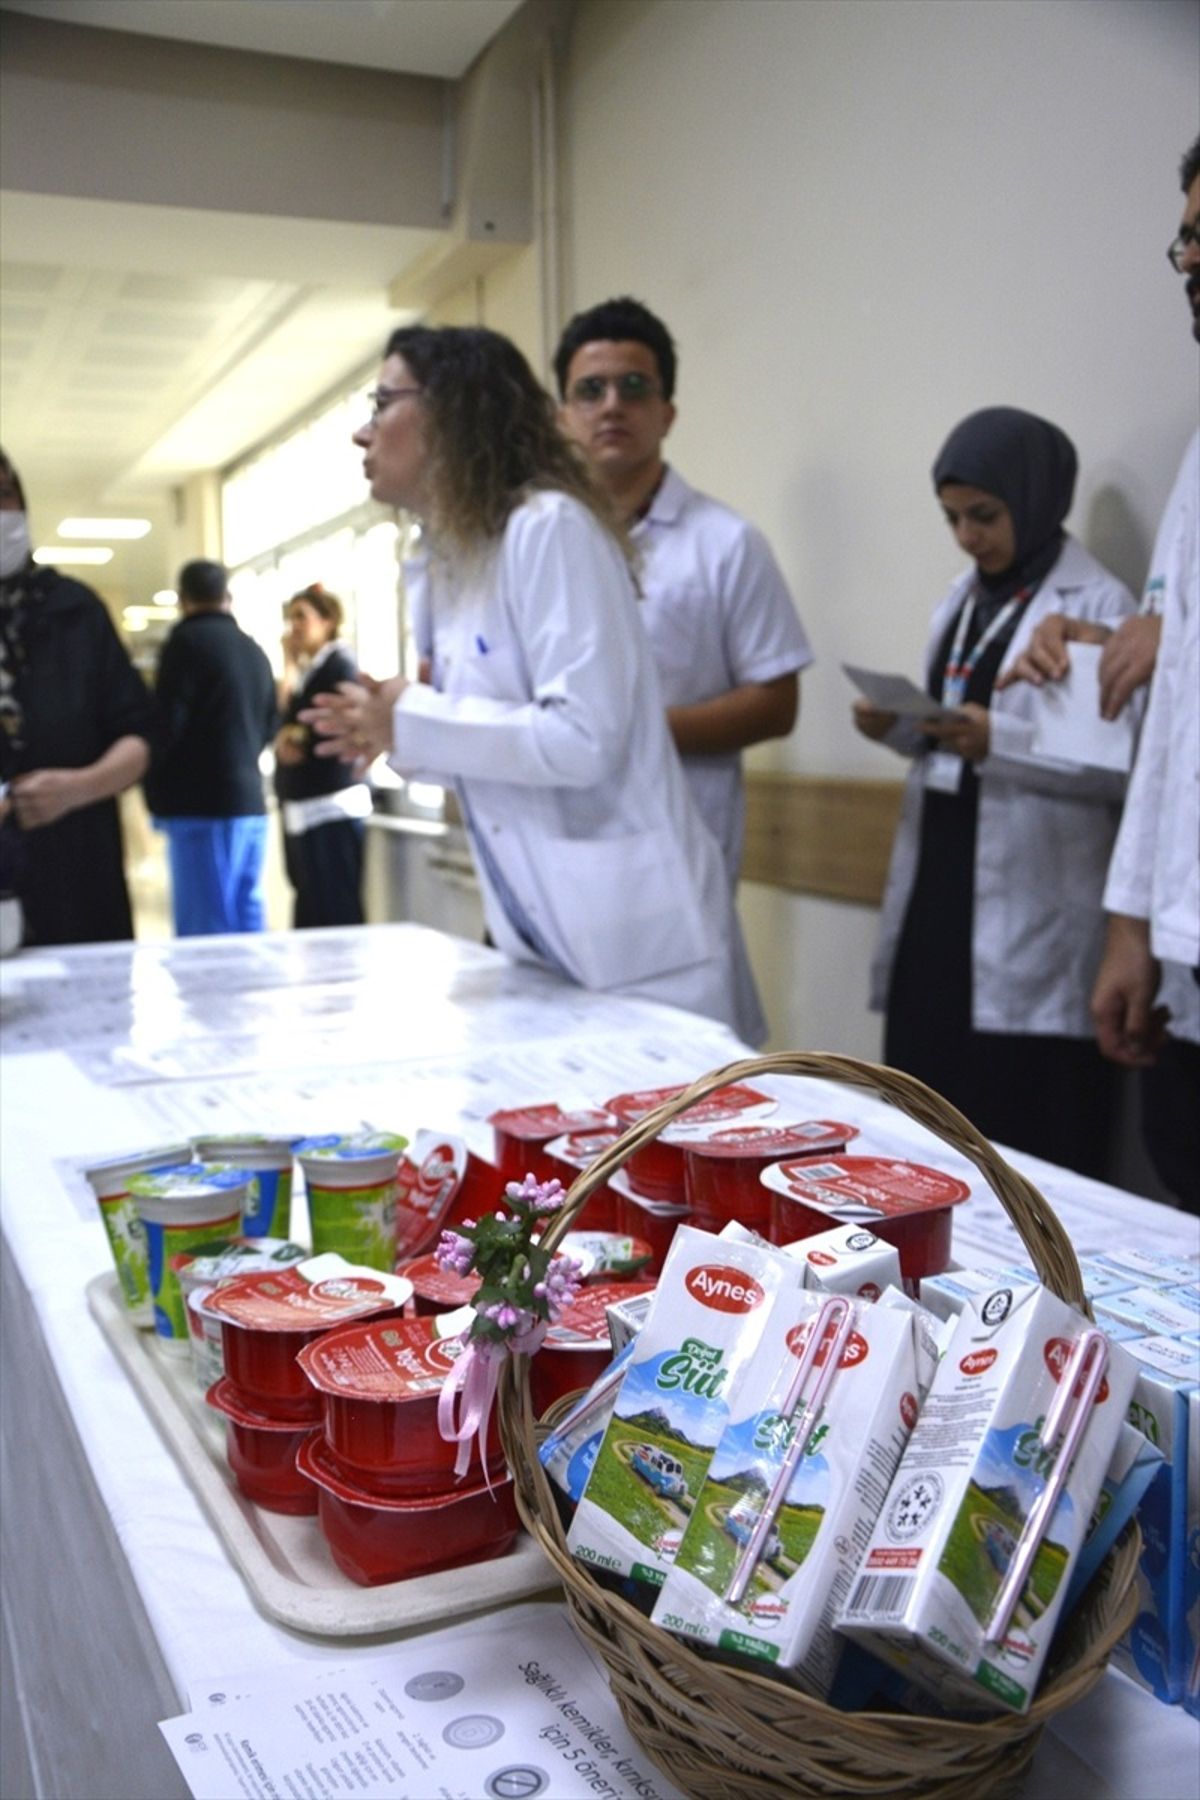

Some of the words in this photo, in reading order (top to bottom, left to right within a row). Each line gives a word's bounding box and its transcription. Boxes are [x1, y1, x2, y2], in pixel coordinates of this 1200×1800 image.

[691, 1270, 759, 1305] Aynes
[656, 1354, 728, 1399] Süt
[576, 1544, 597, 1561] 200
[662, 1613, 684, 1629] 200
[683, 1620, 700, 1634] ml
[518, 1660, 567, 1702] Sağlıklı
[557, 1700, 618, 1759] kemikler,
[538, 1723, 571, 1750] için
[562, 1748, 586, 1761] 5
